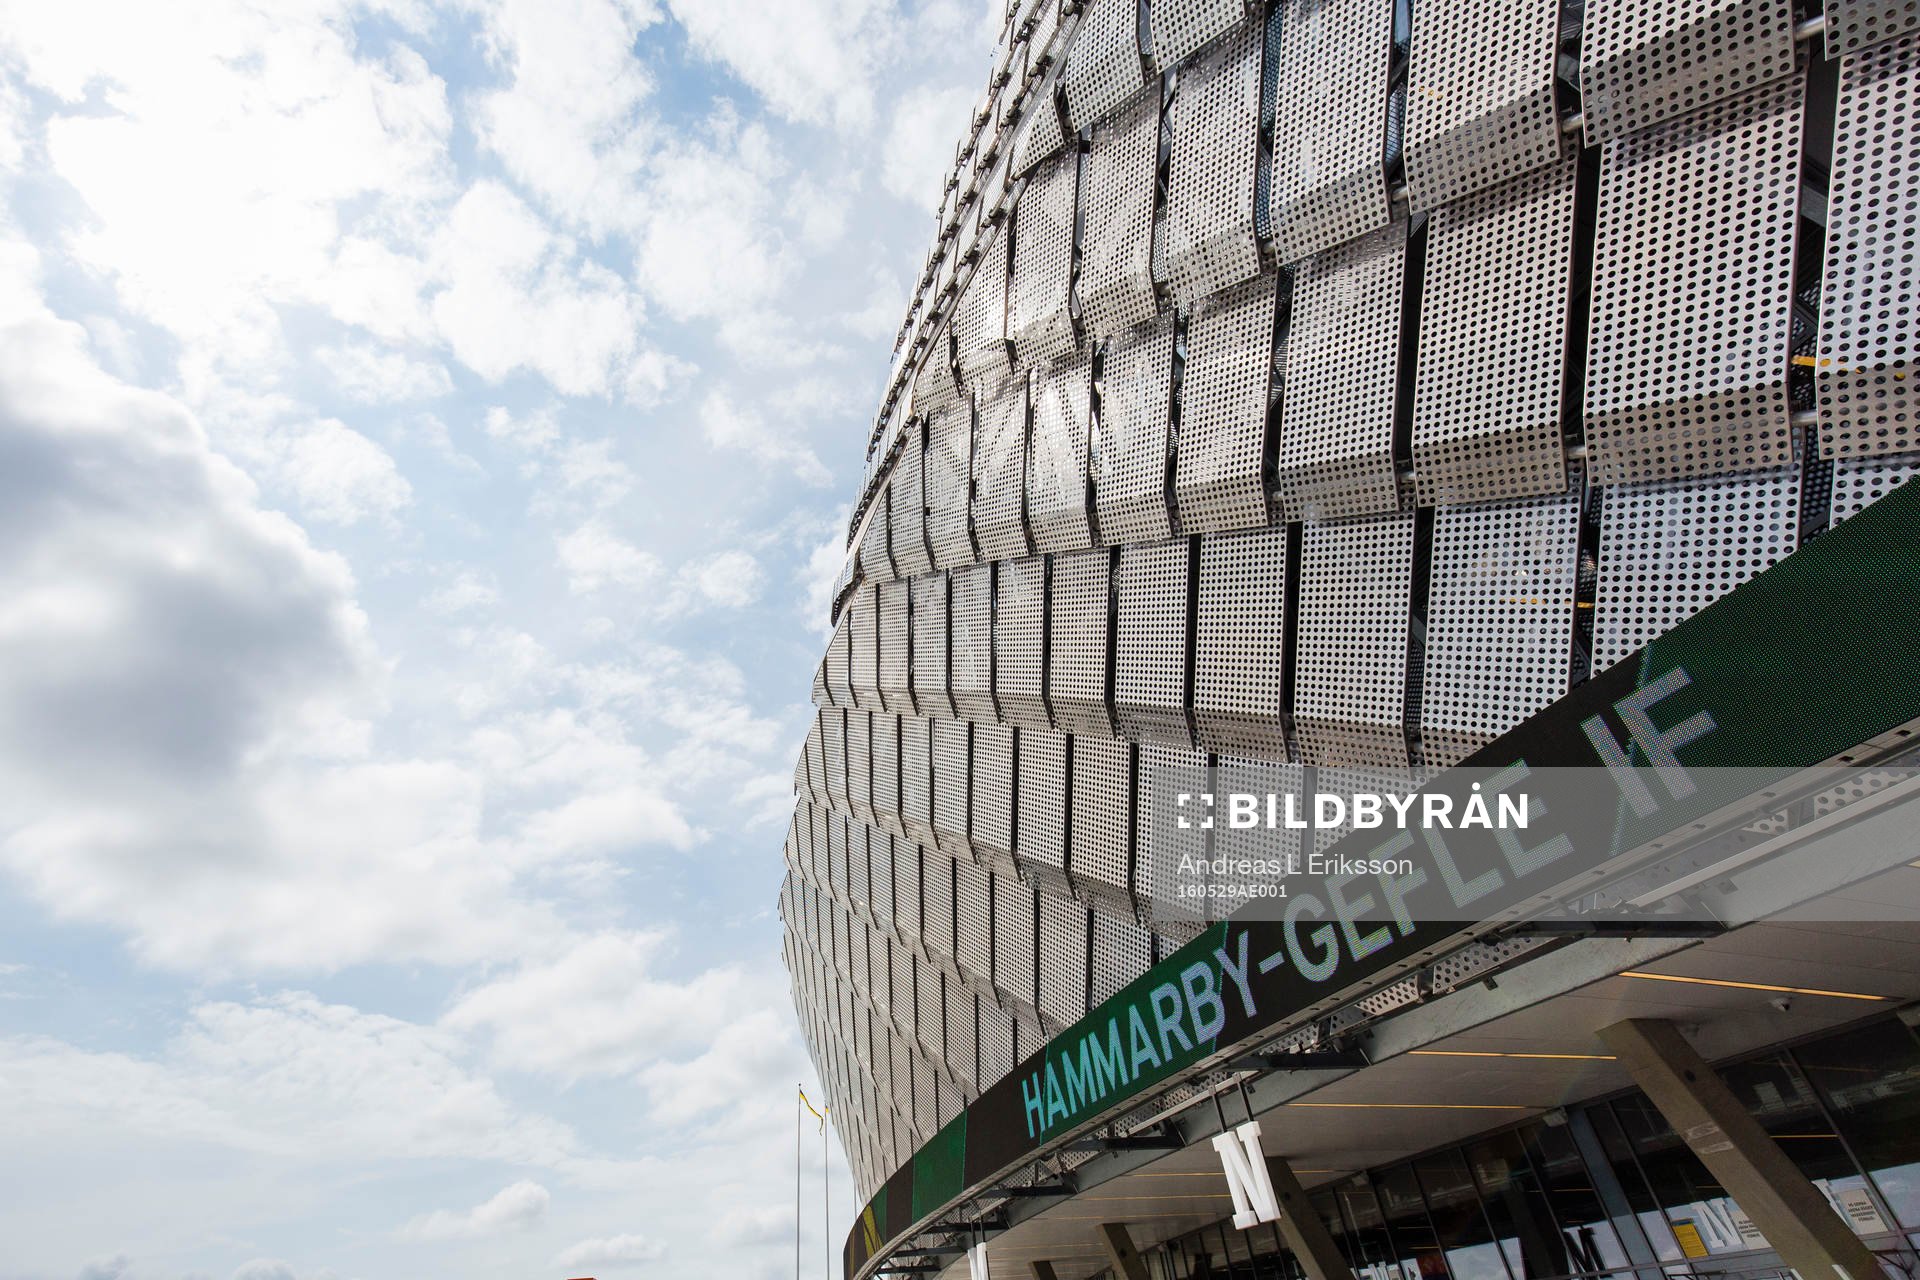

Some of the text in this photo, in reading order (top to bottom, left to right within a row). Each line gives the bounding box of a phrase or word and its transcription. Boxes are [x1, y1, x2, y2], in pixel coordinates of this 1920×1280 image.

[1579, 665, 1719, 819] IF
[1211, 1120, 1281, 1231] N
[1690, 1197, 1744, 1249] N
